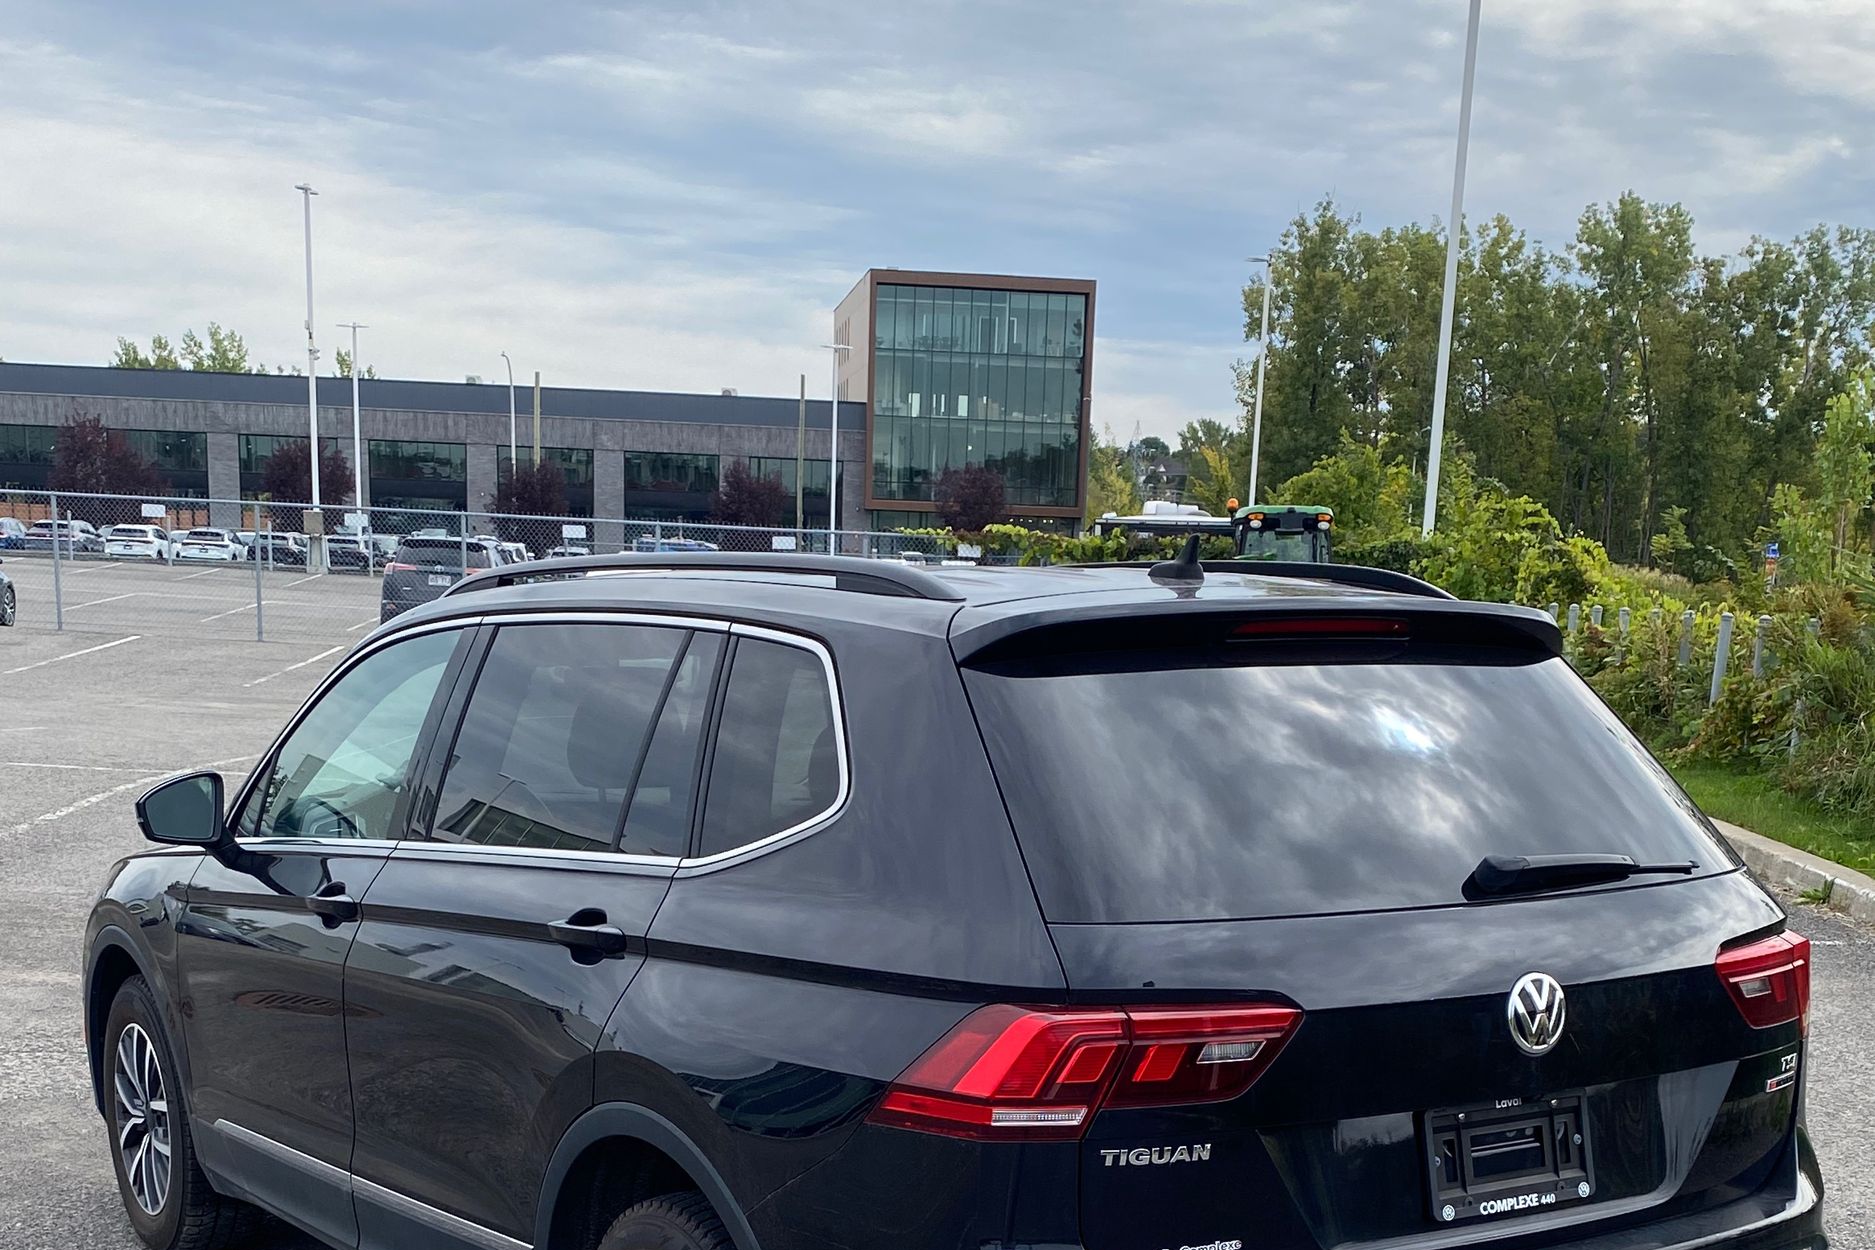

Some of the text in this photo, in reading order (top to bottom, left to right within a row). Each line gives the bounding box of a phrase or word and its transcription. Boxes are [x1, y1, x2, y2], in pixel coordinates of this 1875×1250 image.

[1495, 1097, 1522, 1109] Laval
[1100, 1143, 1212, 1166] TIGUAN
[1479, 1193, 1556, 1215] COMPLEXE 440
